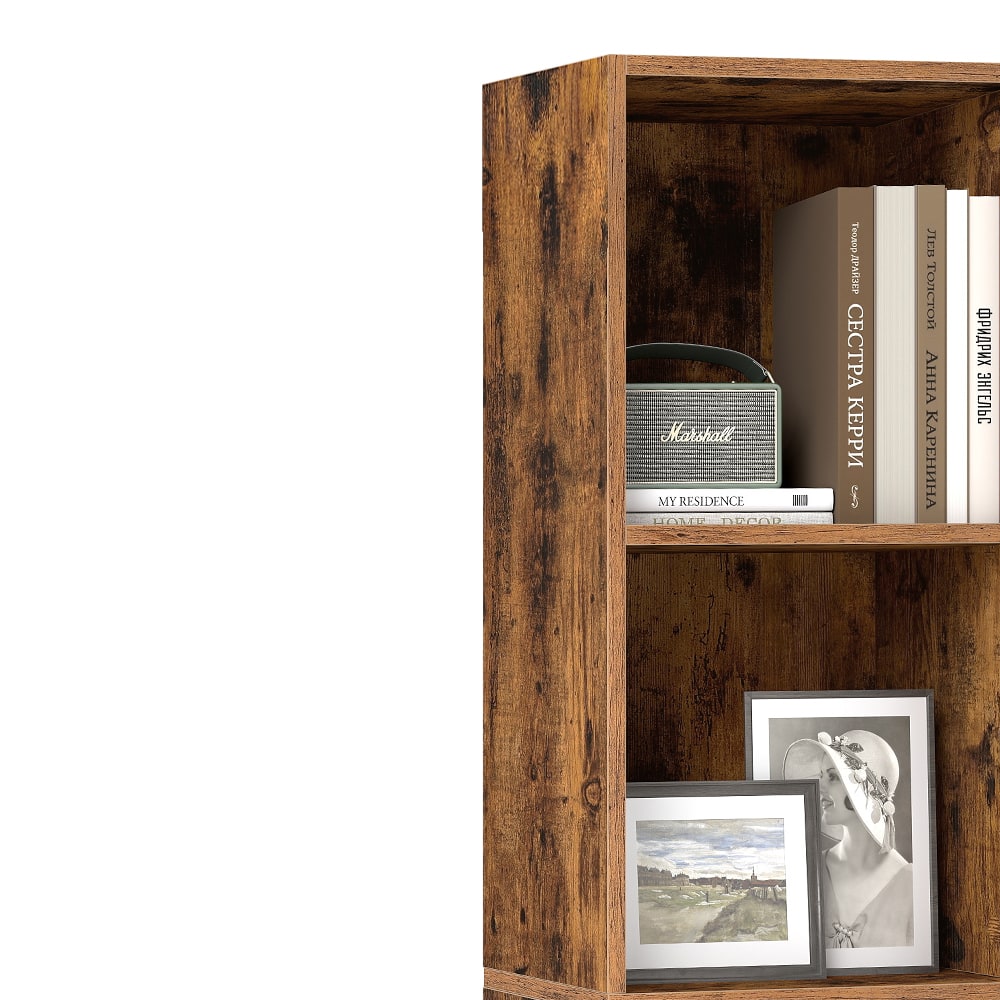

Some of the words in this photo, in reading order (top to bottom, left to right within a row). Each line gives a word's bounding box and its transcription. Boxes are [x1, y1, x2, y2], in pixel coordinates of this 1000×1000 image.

[850, 221, 860, 253] Теодор
[850, 254, 861, 295] ДРАЙЗЕР
[847, 303, 864, 390] СЕСТРА
[976, 308, 993, 367] ФРИДРИХ
[926, 350, 938, 405] АННА
[977, 372, 992, 424] ЭНГЕЛЬС
[660, 421, 736, 443] Marshall
[847, 396, 864, 468] КЕРРИ
[926, 410, 939, 510] КАРЕНИНА
[658, 496, 677, 507] MY
[679, 496, 745, 507] RESIDENCE
